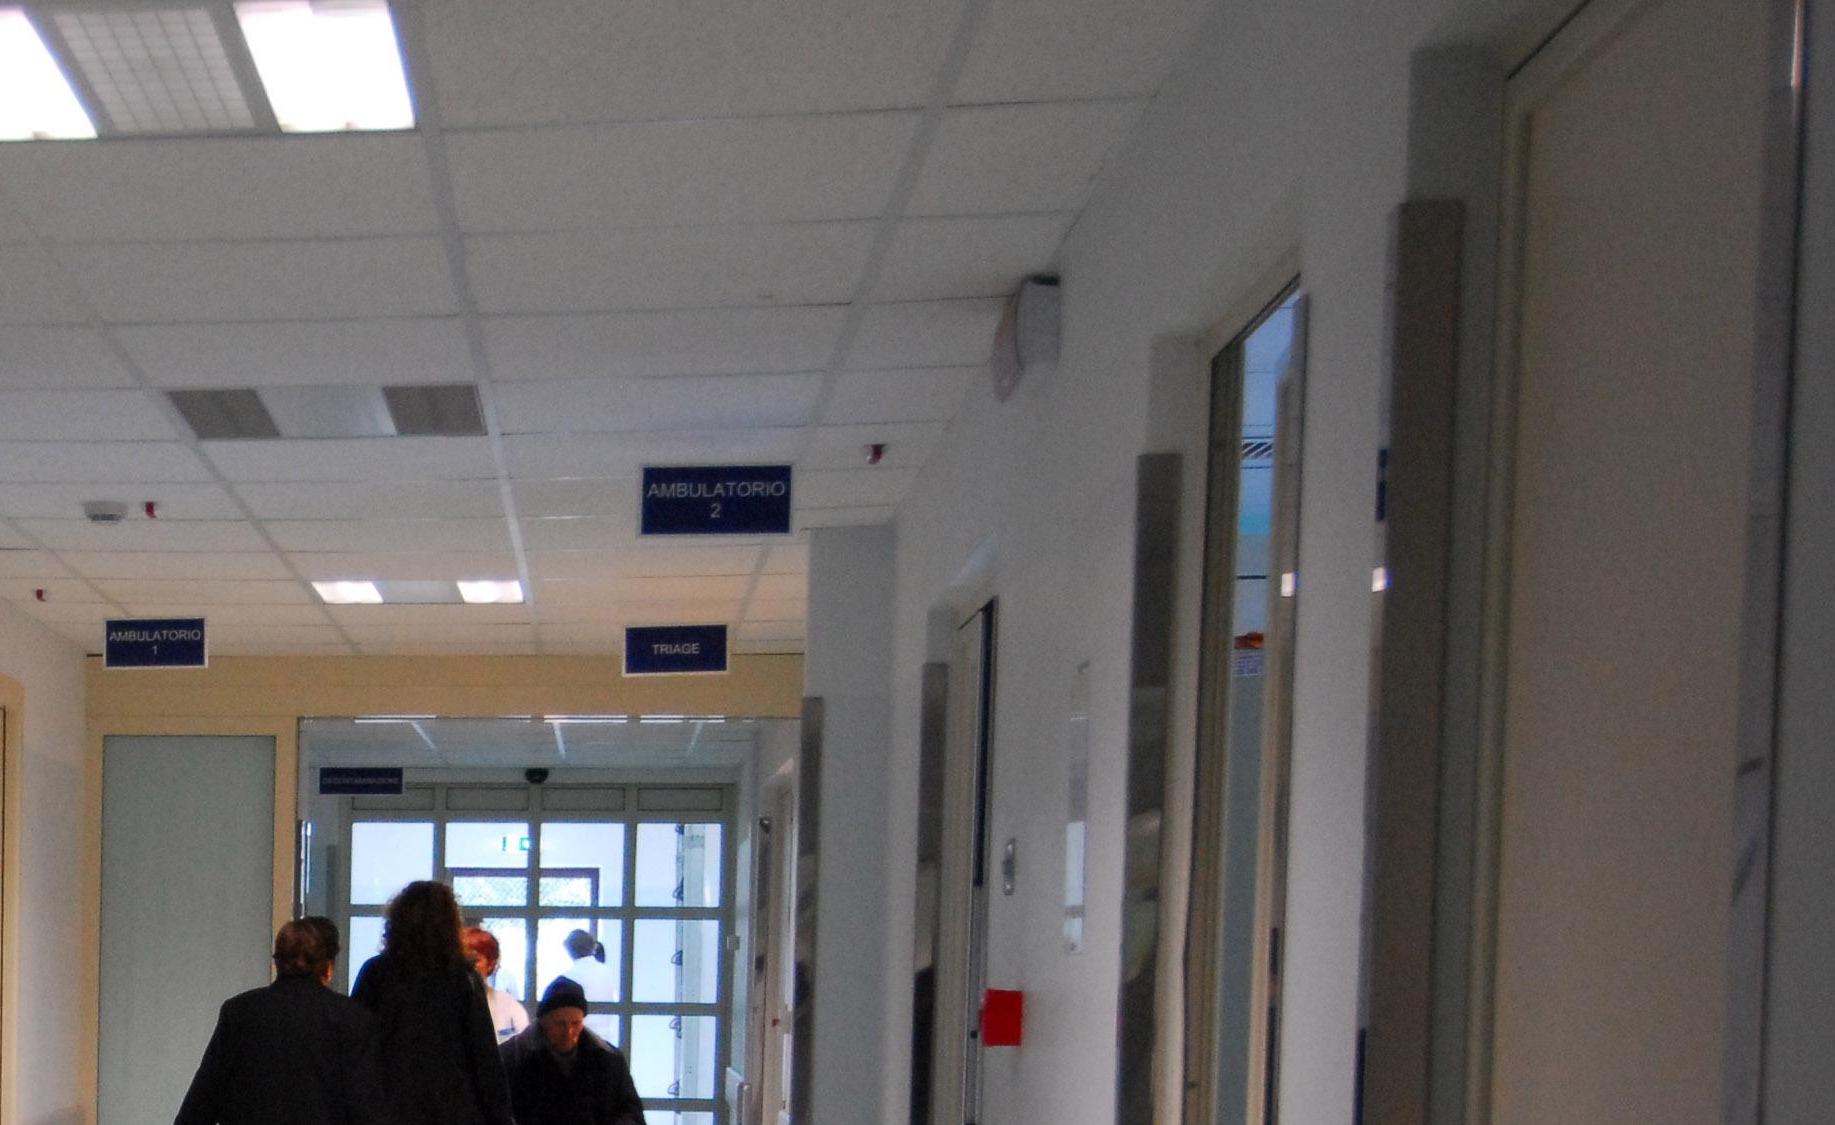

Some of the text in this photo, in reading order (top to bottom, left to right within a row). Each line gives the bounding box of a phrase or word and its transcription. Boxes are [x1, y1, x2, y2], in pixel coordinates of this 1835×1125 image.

[647, 480, 786, 499] AMBULATORIO
[710, 502, 721, 519] 2
[109, 629, 201, 642] AMBULATORIO
[152, 645, 158, 655] 1
[651, 642, 700, 655] TRIAGE
